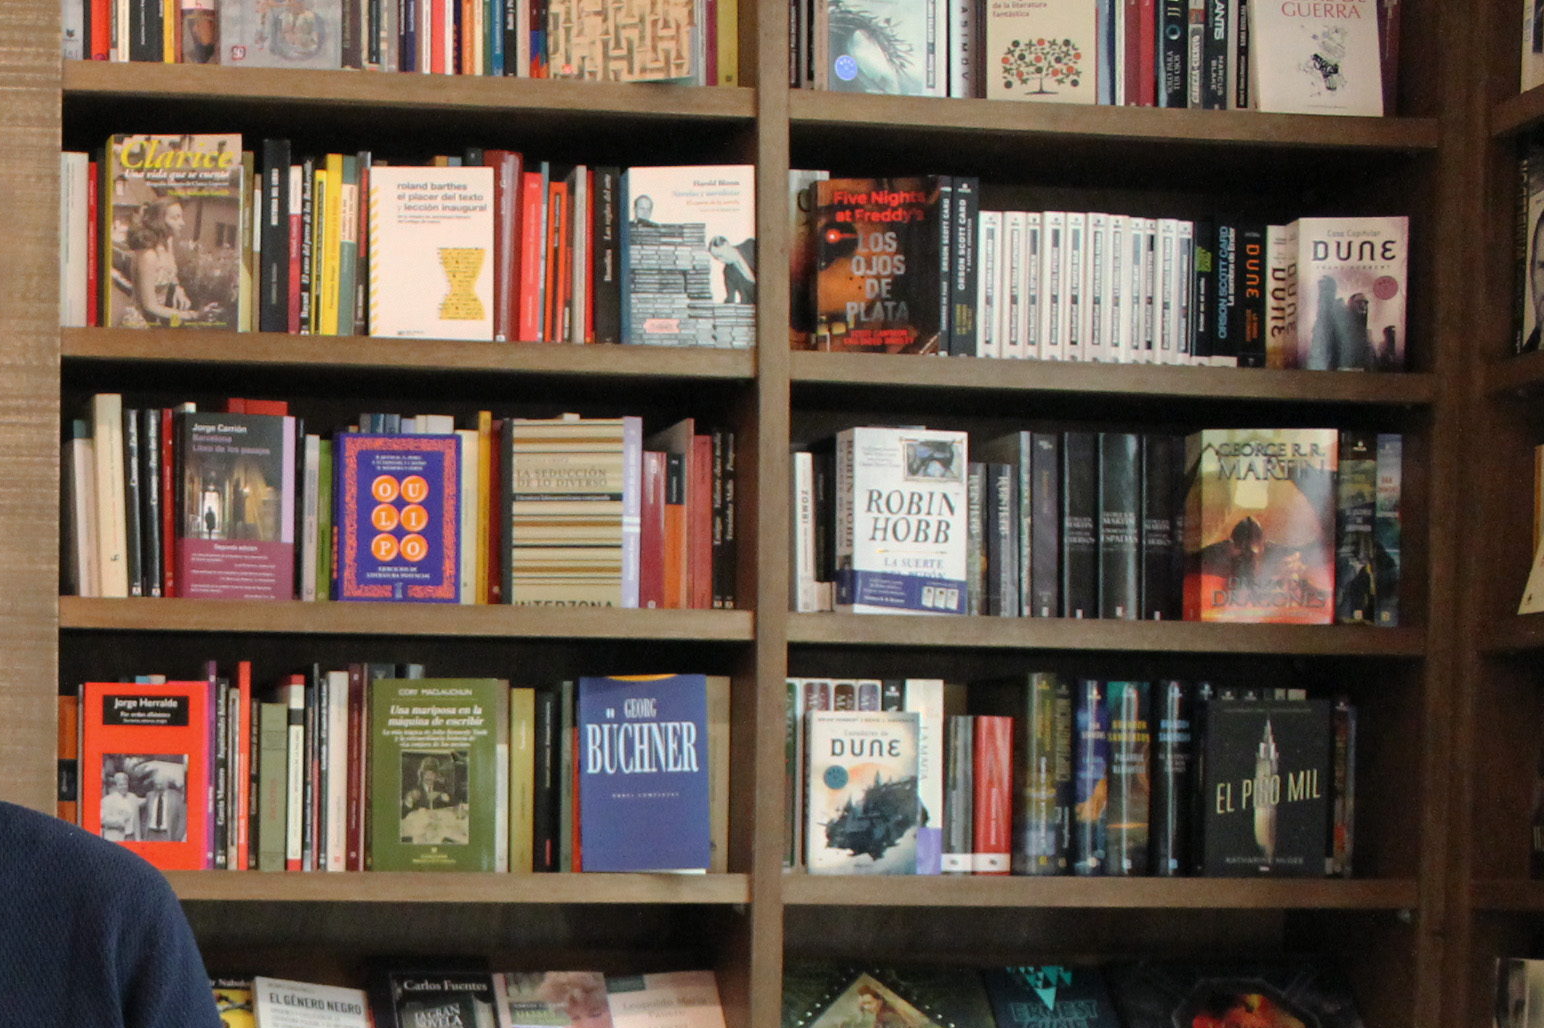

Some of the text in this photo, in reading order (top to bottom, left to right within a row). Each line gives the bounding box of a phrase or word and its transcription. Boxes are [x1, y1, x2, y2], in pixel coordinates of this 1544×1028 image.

[120, 138, 234, 171] Clarice
[398, 182, 467, 191] roland barthes
[398, 193, 483, 203] el placer del texto
[404, 202, 487, 214] lección inaugural
[834, 190, 926, 206] Five Nights
[835, 208, 924, 224] at Freddy's
[858, 232, 897, 252] LOS
[958, 199, 966, 290] ORSON SCOTT CARD
[1312, 240, 1396, 262] DUNE
[851, 255, 905, 275] OJOS
[866, 278, 892, 299] DE
[1219, 226, 1227, 338] ORSON SCOTT CARD
[846, 300, 909, 322] PLATA
[192, 424, 247, 434] Jorge Carrión
[1218, 443, 1287, 457] GEORGE
[1217, 459, 1325, 480] MARTIN
[866, 490, 956, 516] ROBIN
[869, 517, 950, 544] HOBB
[115, 698, 178, 710] Jorge Herralde
[390, 705, 409, 715] Una
[624, 697, 656, 718] GEORG
[587, 708, 698, 774] BÜCHNER
[831, 738, 901, 757] DUNE
[1216, 769, 1320, 814] EL MIL
[403, 980, 487, 992] Carlos Fuentes
[269, 992, 362, 1015] EL GÉNERO NEGRO
